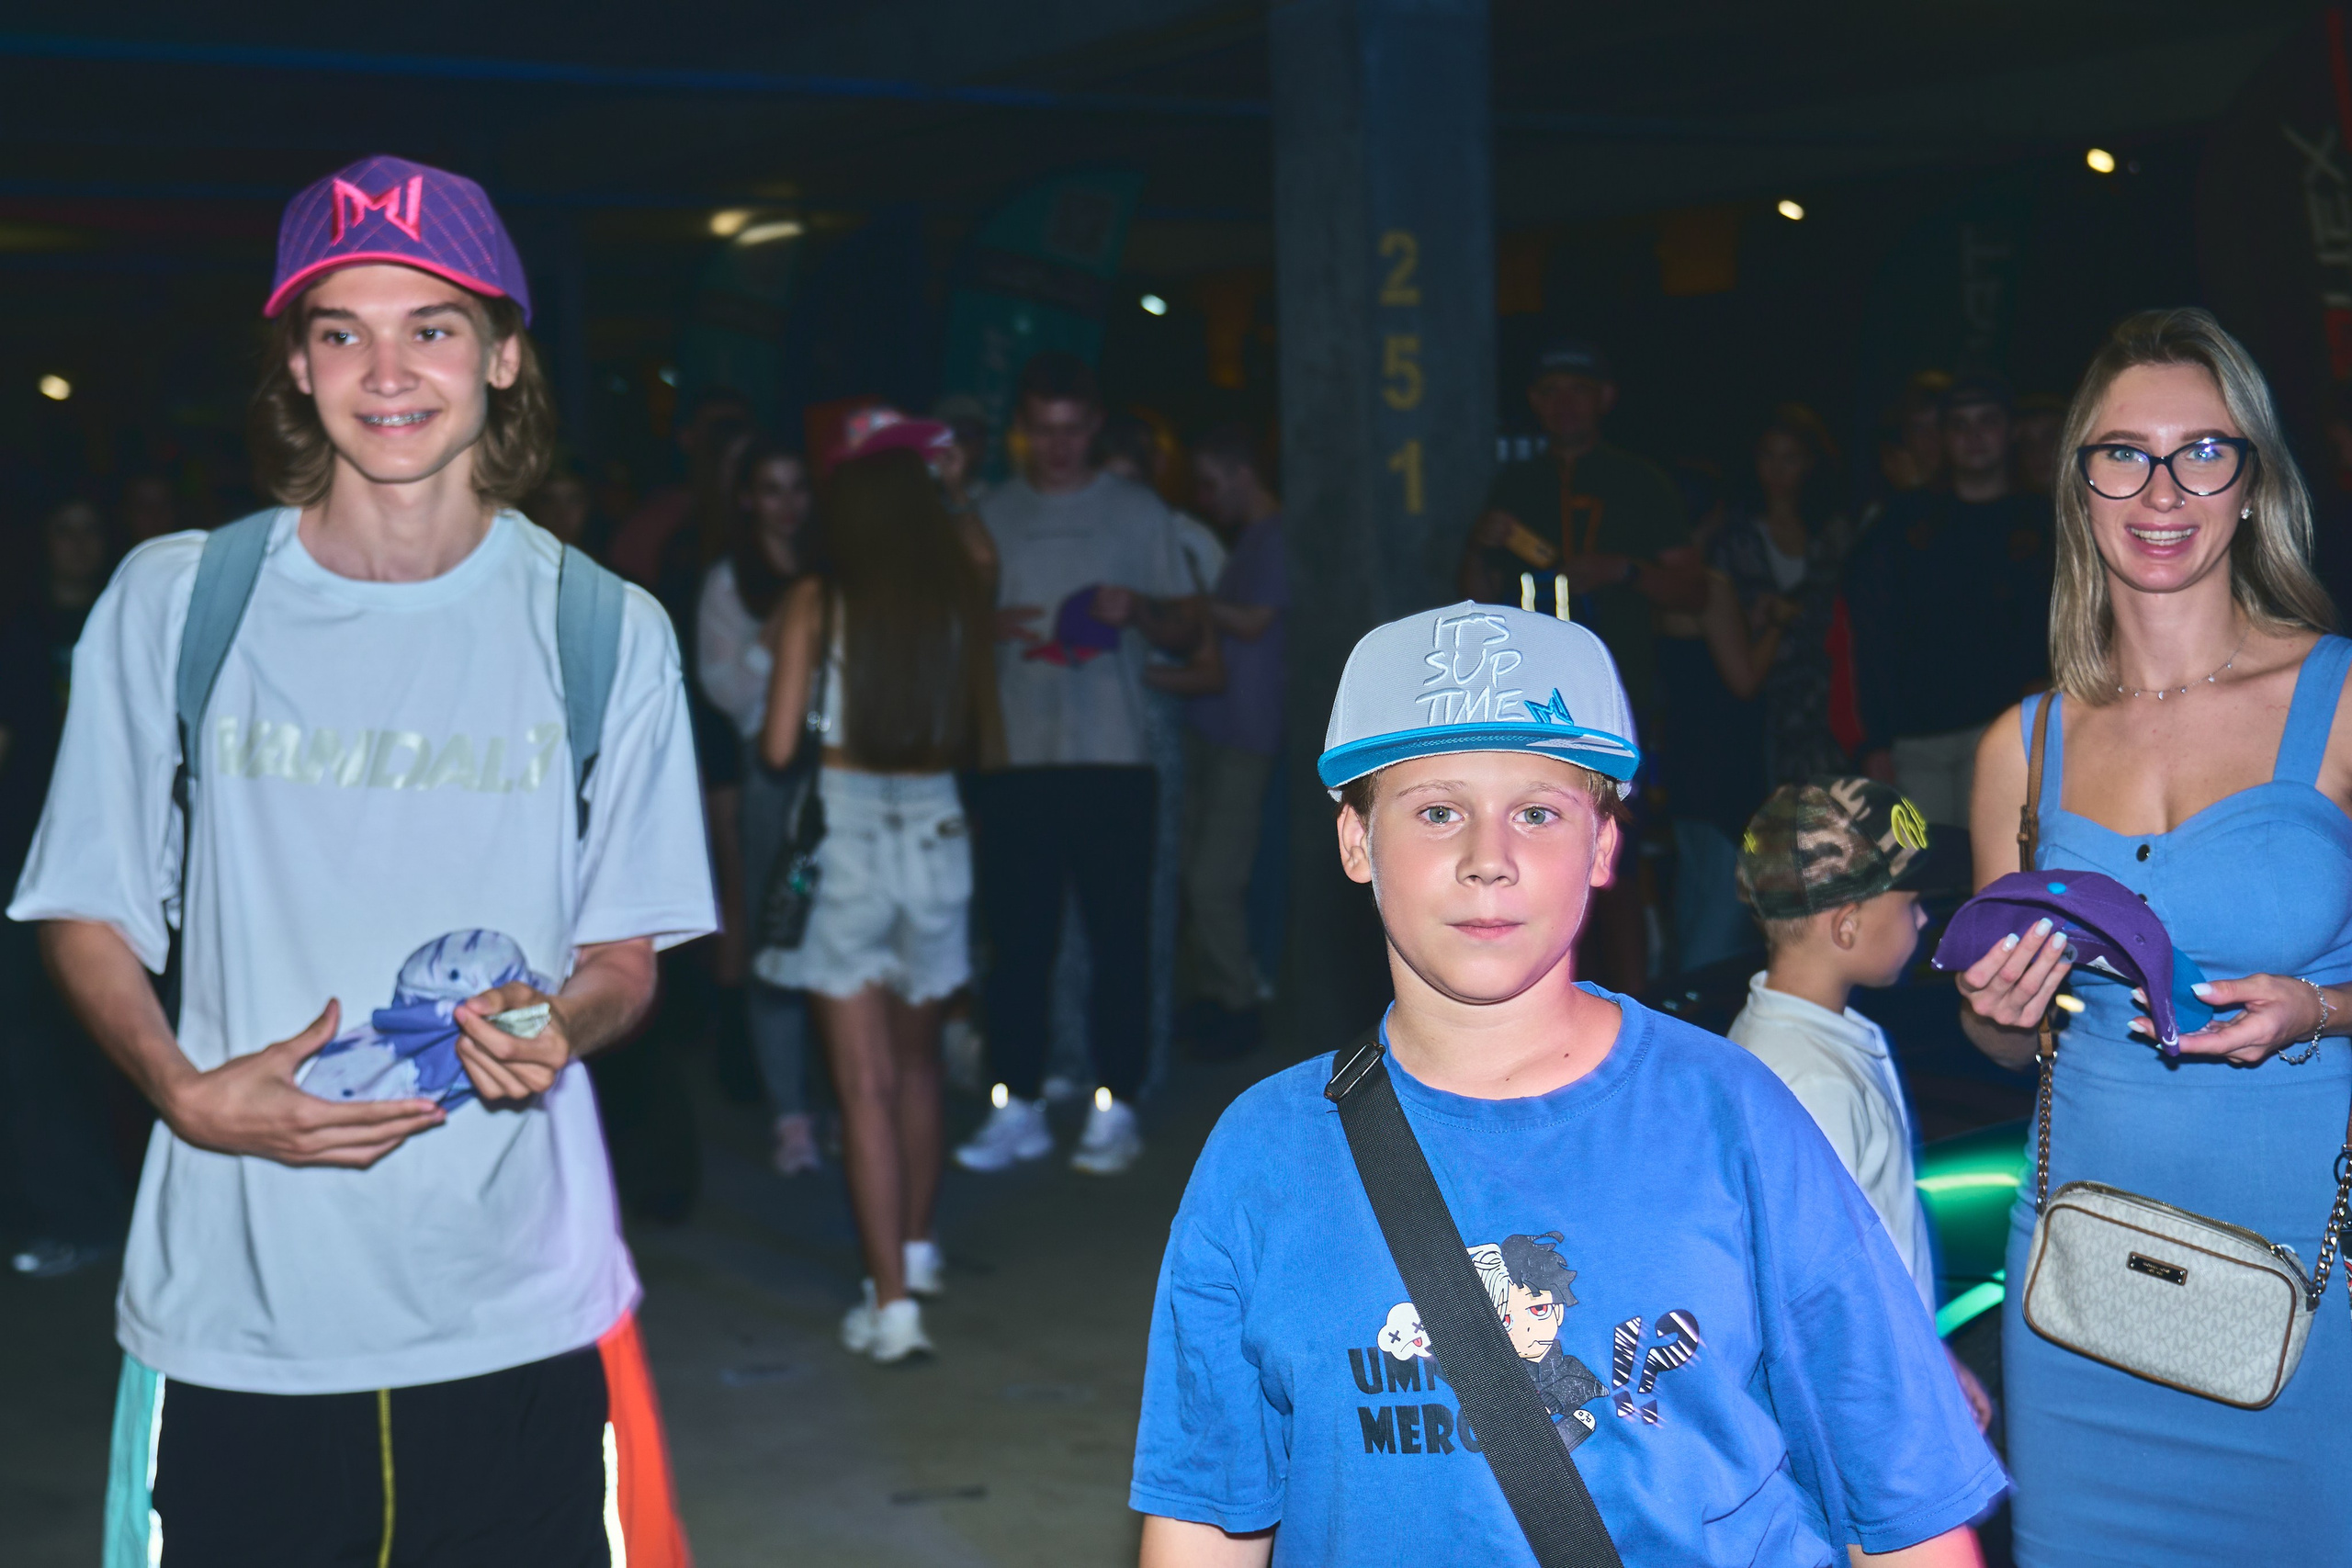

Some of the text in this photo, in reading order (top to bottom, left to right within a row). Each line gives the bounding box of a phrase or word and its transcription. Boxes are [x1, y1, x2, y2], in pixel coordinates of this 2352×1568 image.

[1378, 230, 1424, 516] 251
[1423, 648, 1523, 688] SUP
[1415, 686, 1525, 726] TIME
